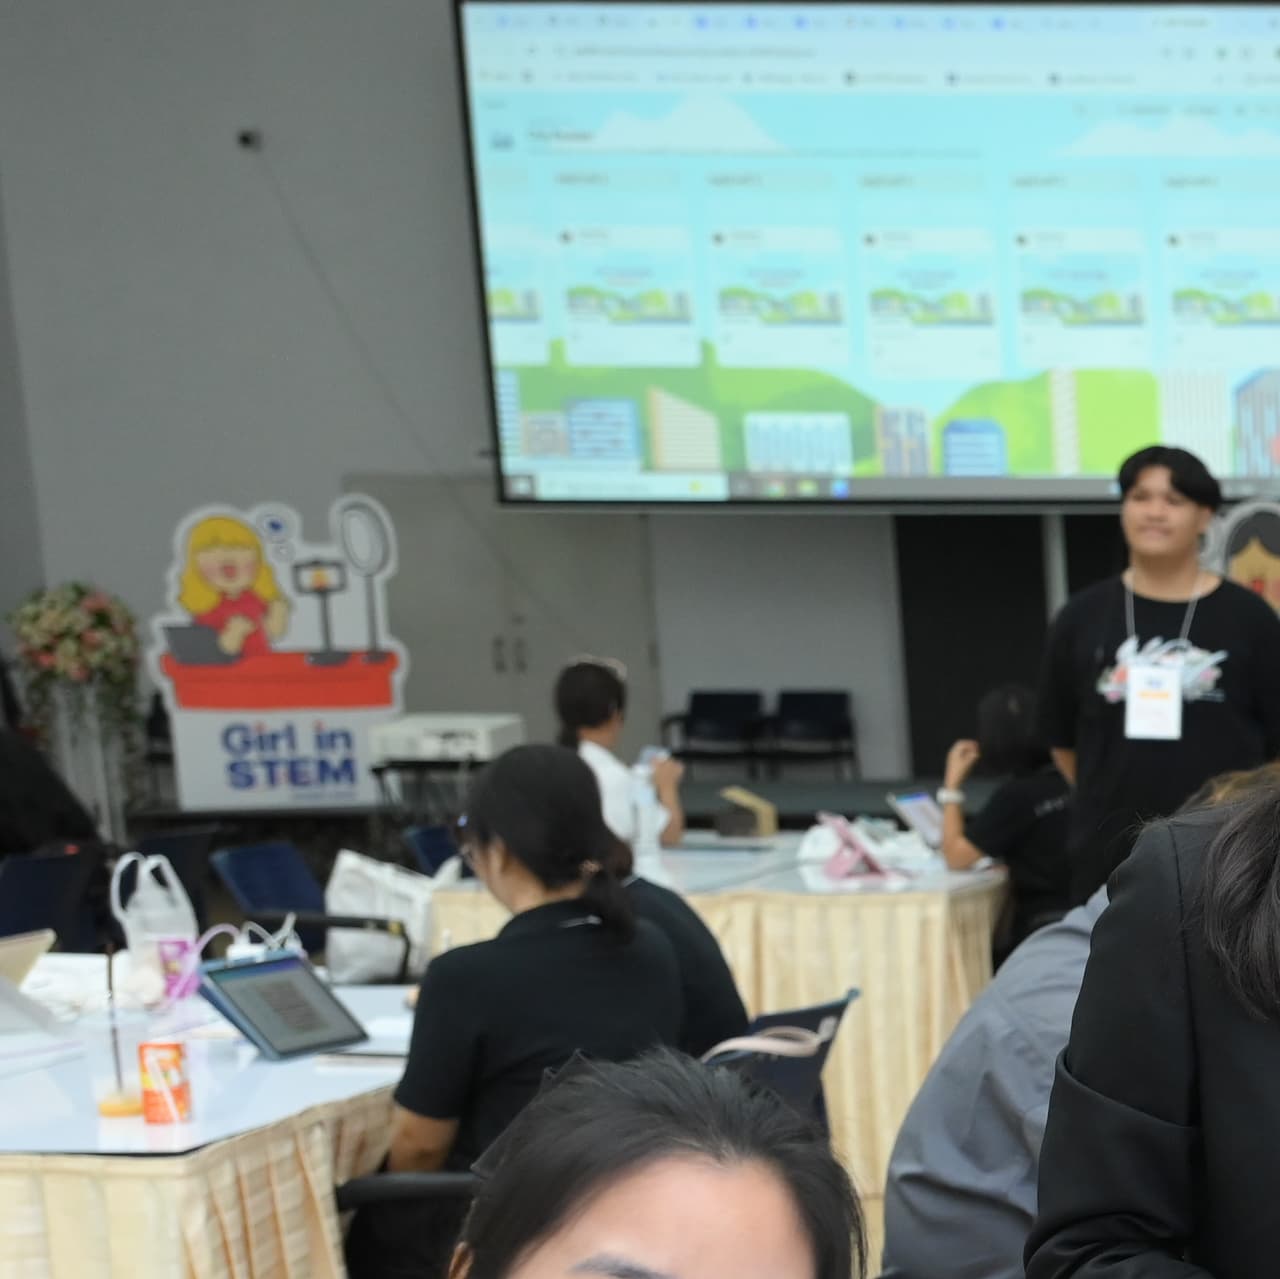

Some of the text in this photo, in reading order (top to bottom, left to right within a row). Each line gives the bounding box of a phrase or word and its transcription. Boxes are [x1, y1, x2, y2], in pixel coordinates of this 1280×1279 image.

[222, 719, 352, 754] Girl in
[228, 757, 355, 790] STEM
